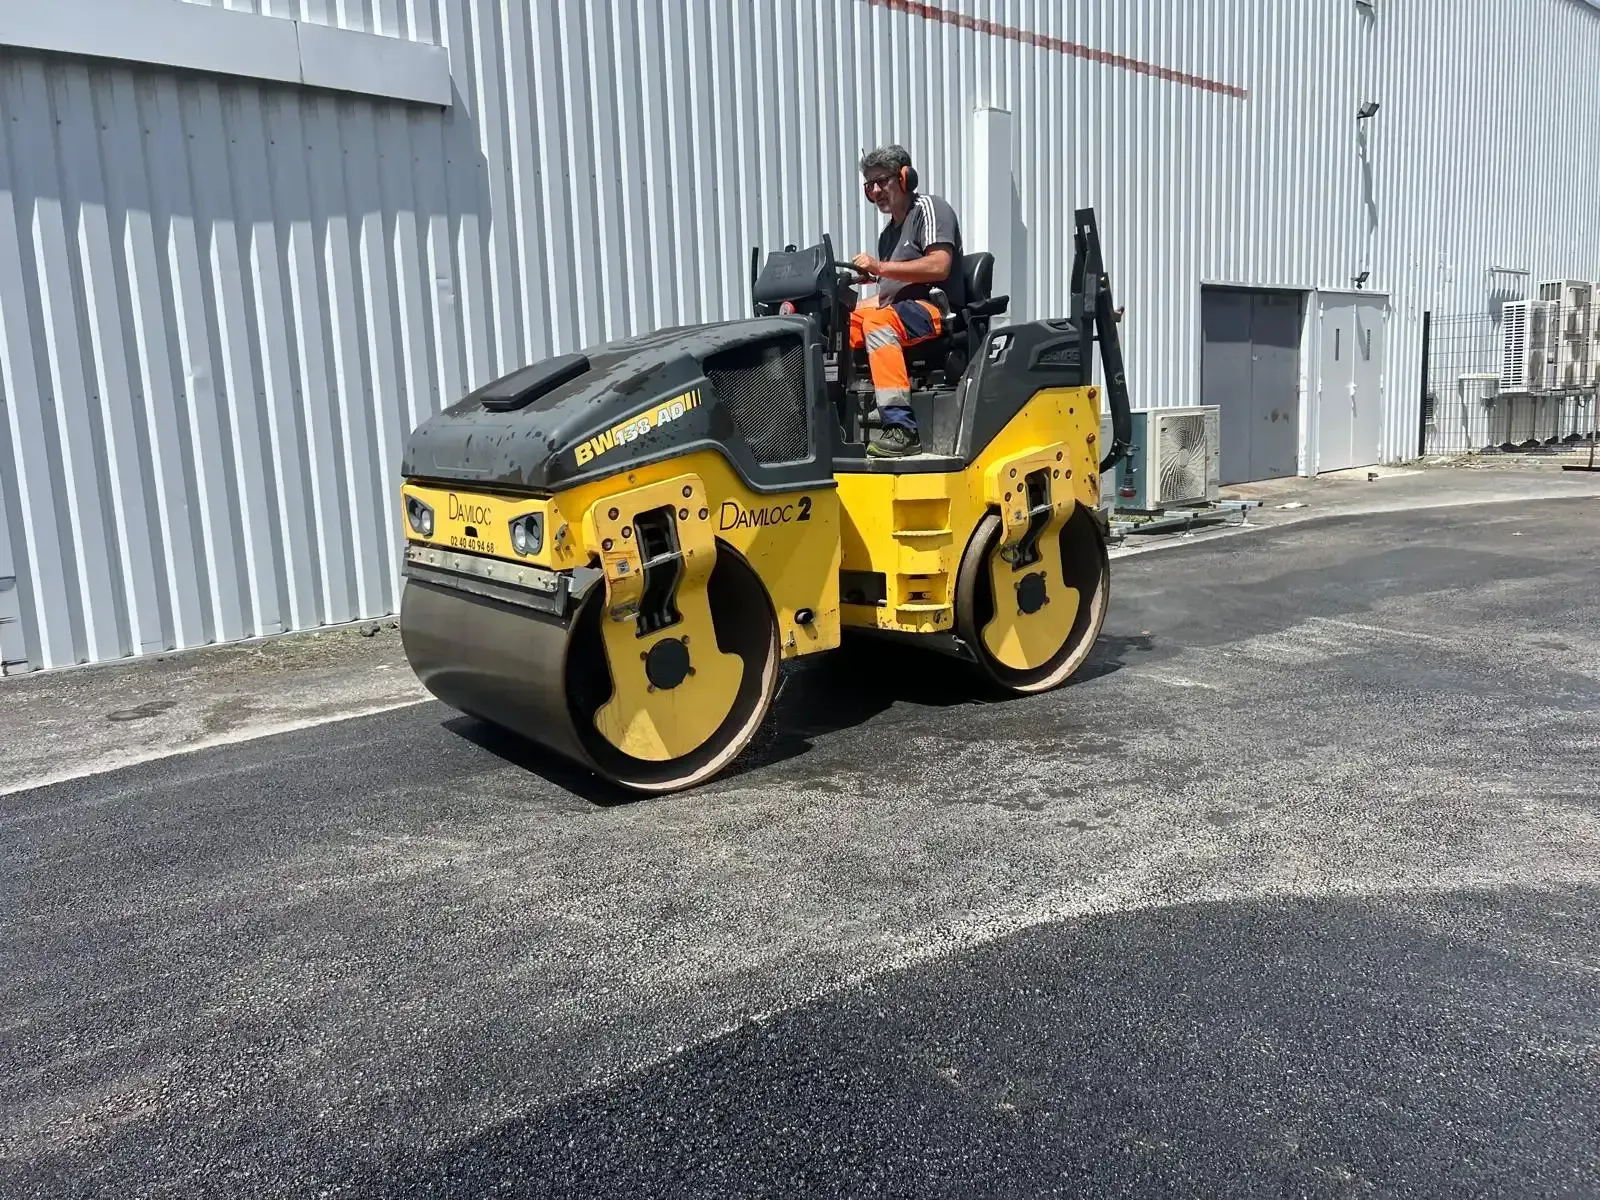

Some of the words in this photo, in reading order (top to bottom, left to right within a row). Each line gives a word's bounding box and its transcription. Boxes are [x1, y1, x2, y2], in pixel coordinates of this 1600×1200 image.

[657, 402, 684, 427] AD
[719, 502, 793, 531] DAMLOC
[796, 496, 812, 521] 2
[450, 535, 458, 546] 02
[459, 537, 467, 548] 40
[468, 539, 476, 550] 40
[477, 540, 485, 551] 94
[486, 542, 495, 553] 68
